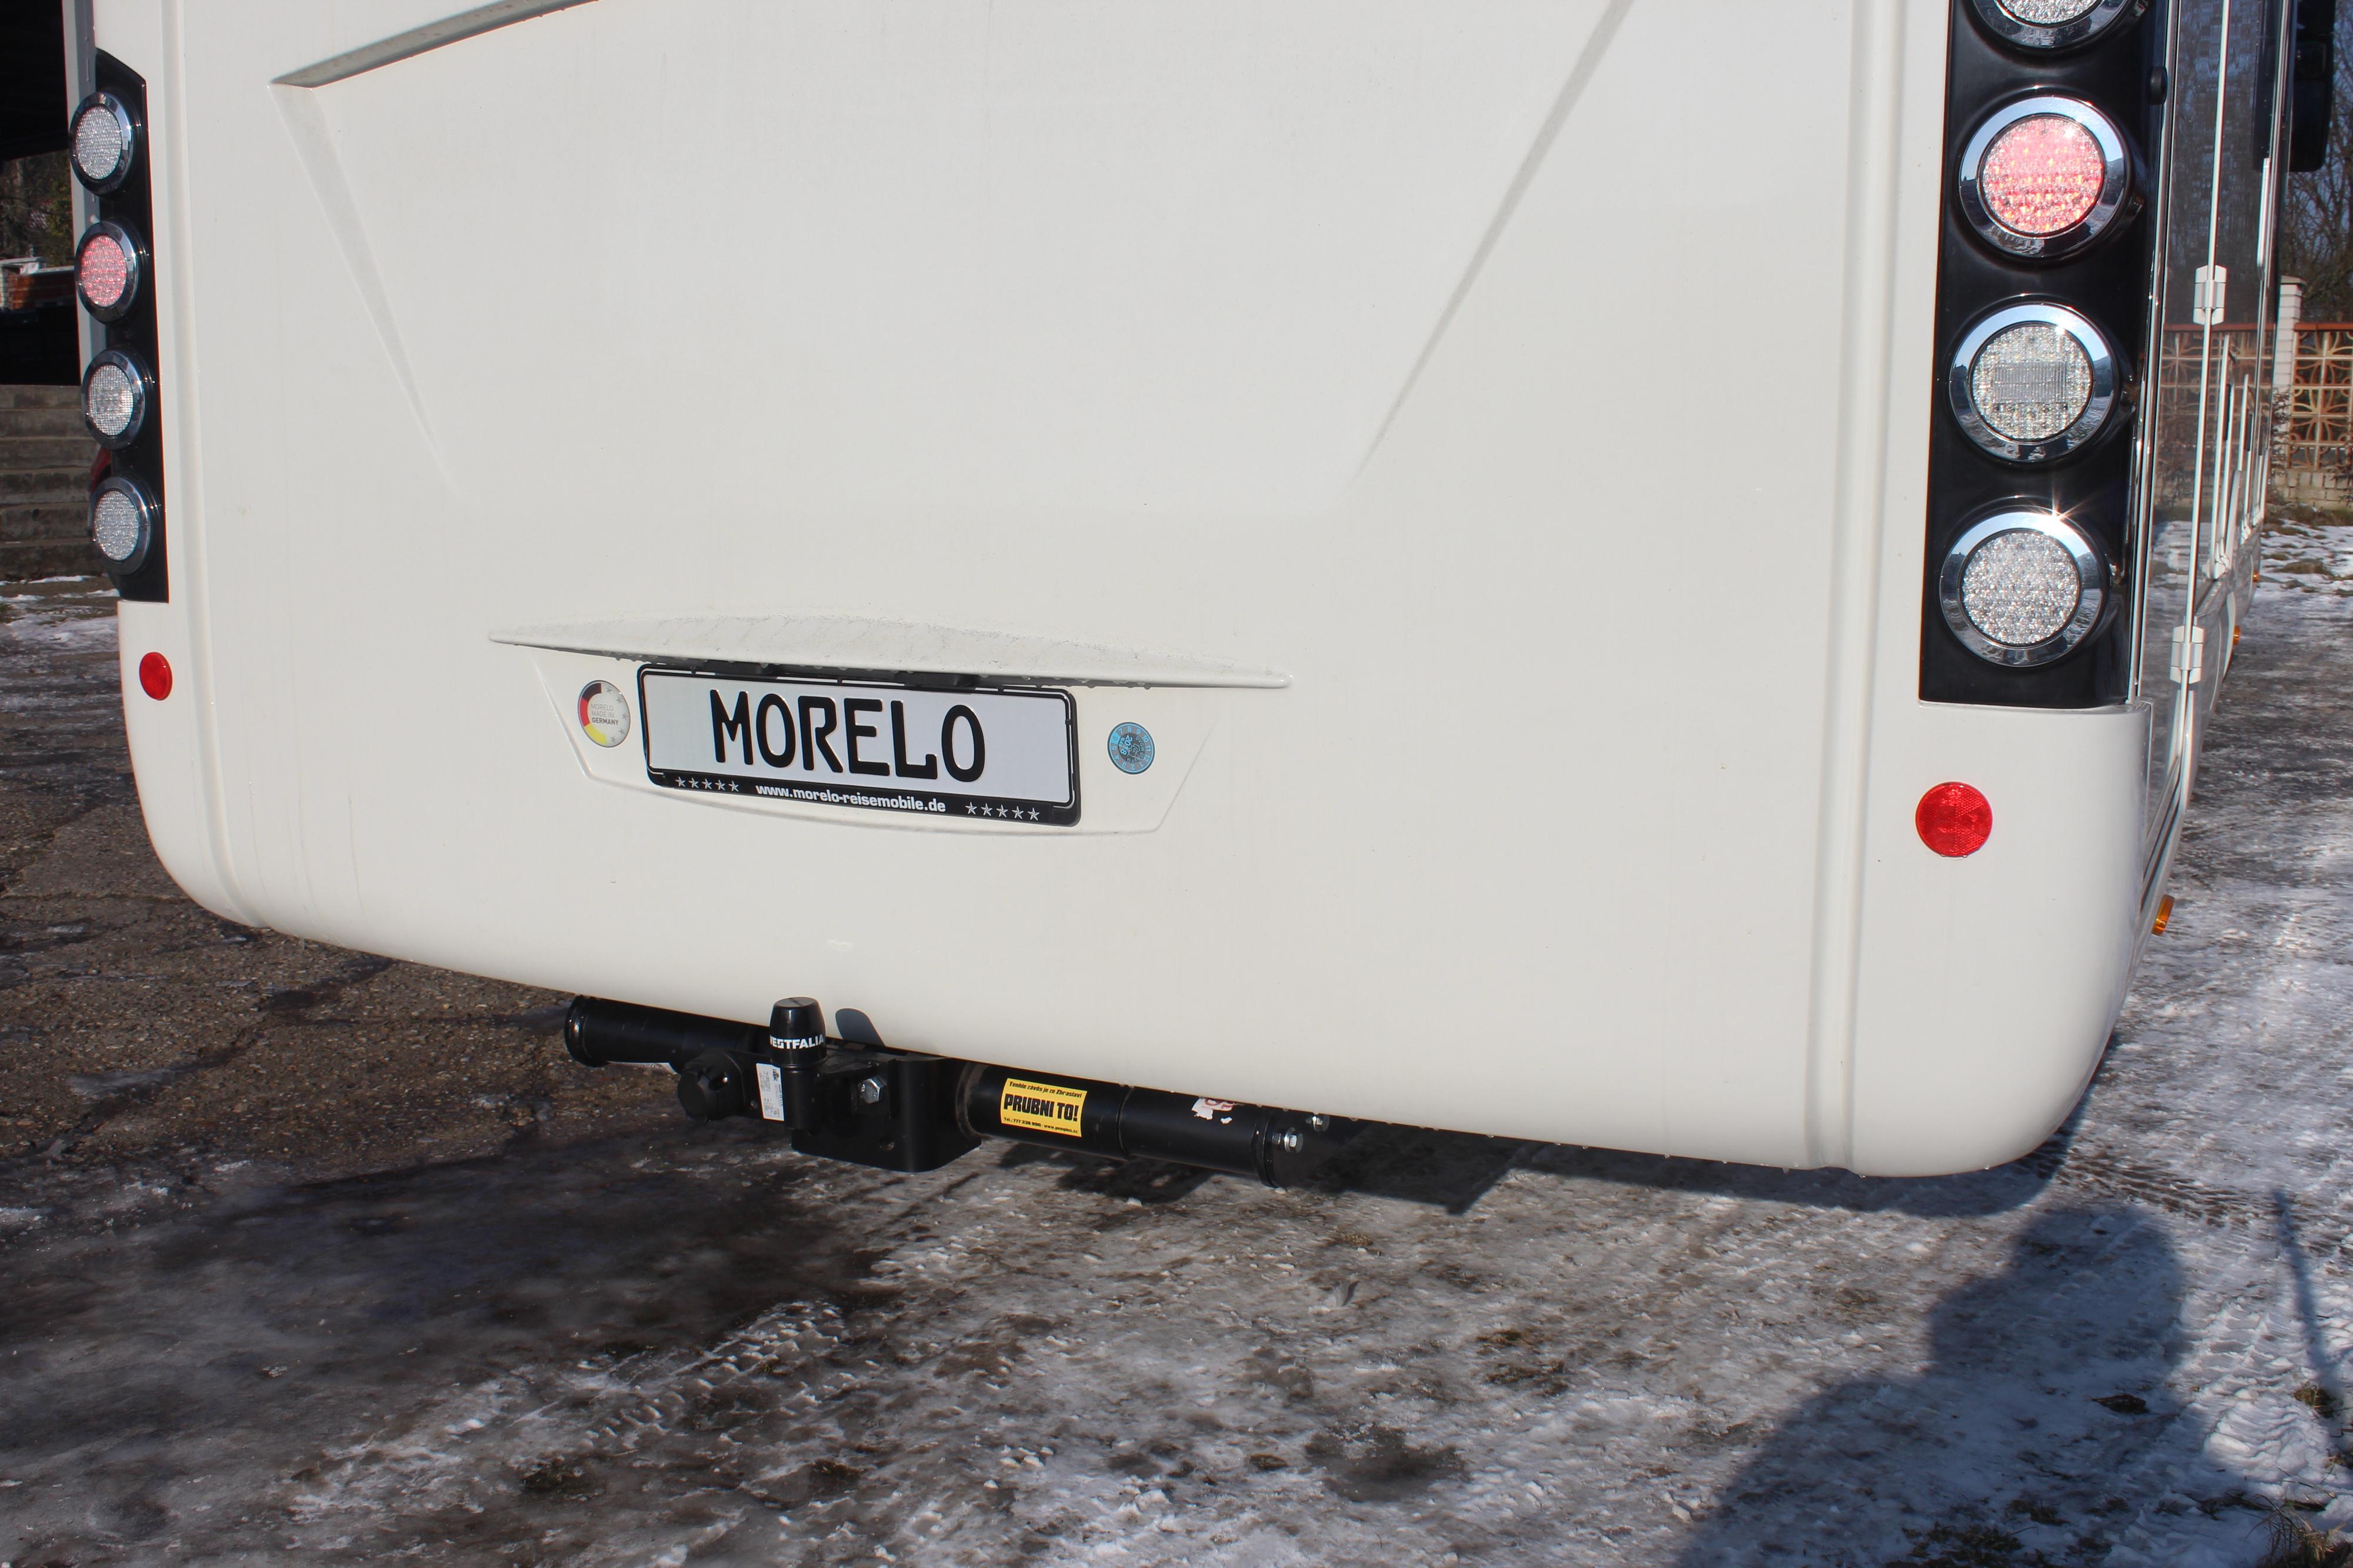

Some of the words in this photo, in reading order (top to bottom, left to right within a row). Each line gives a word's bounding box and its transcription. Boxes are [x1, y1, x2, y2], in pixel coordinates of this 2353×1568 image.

[592, 717, 619, 725] GERMANY
[710, 689, 985, 782] MORELO
[1121, 735, 1132, 755] 2018
[756, 784, 946, 812] www.morelo-reisemobile.de
[1004, 1093, 1055, 1117] PRUBNI
[1057, 1102, 1079, 1122] TO!
